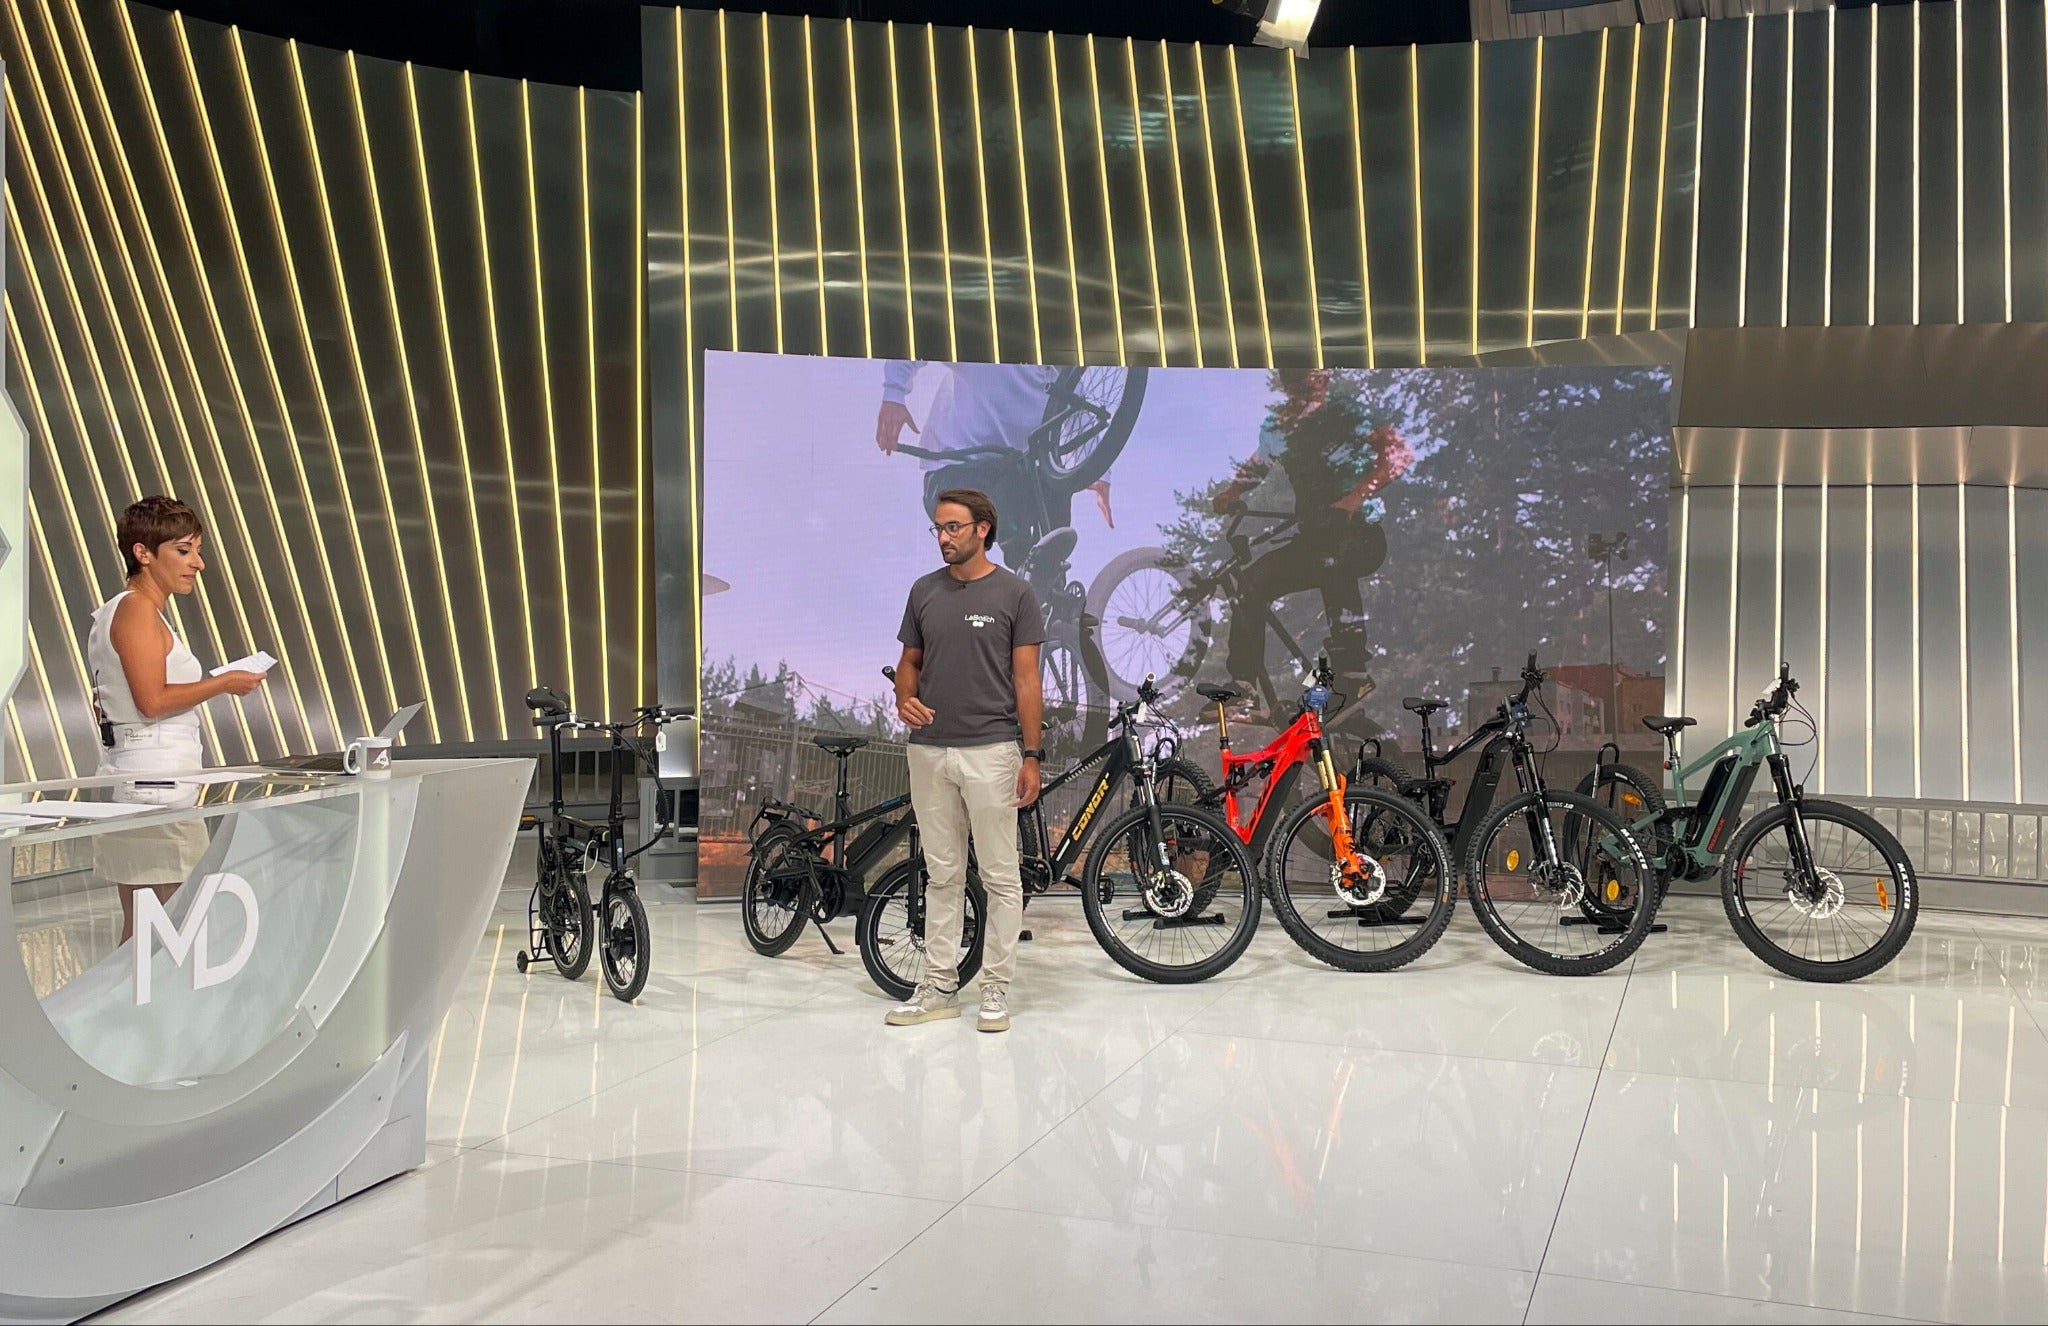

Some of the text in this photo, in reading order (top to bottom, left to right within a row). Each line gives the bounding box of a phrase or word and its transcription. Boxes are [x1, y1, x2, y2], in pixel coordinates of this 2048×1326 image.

[1072, 778, 1109, 841] CONOR
[1427, 830, 1450, 893] SCHWALBE
[1620, 828, 1649, 870] MAXXIS
[1896, 862, 1911, 910] MAXXIS
[133, 872, 260, 1006] MD
